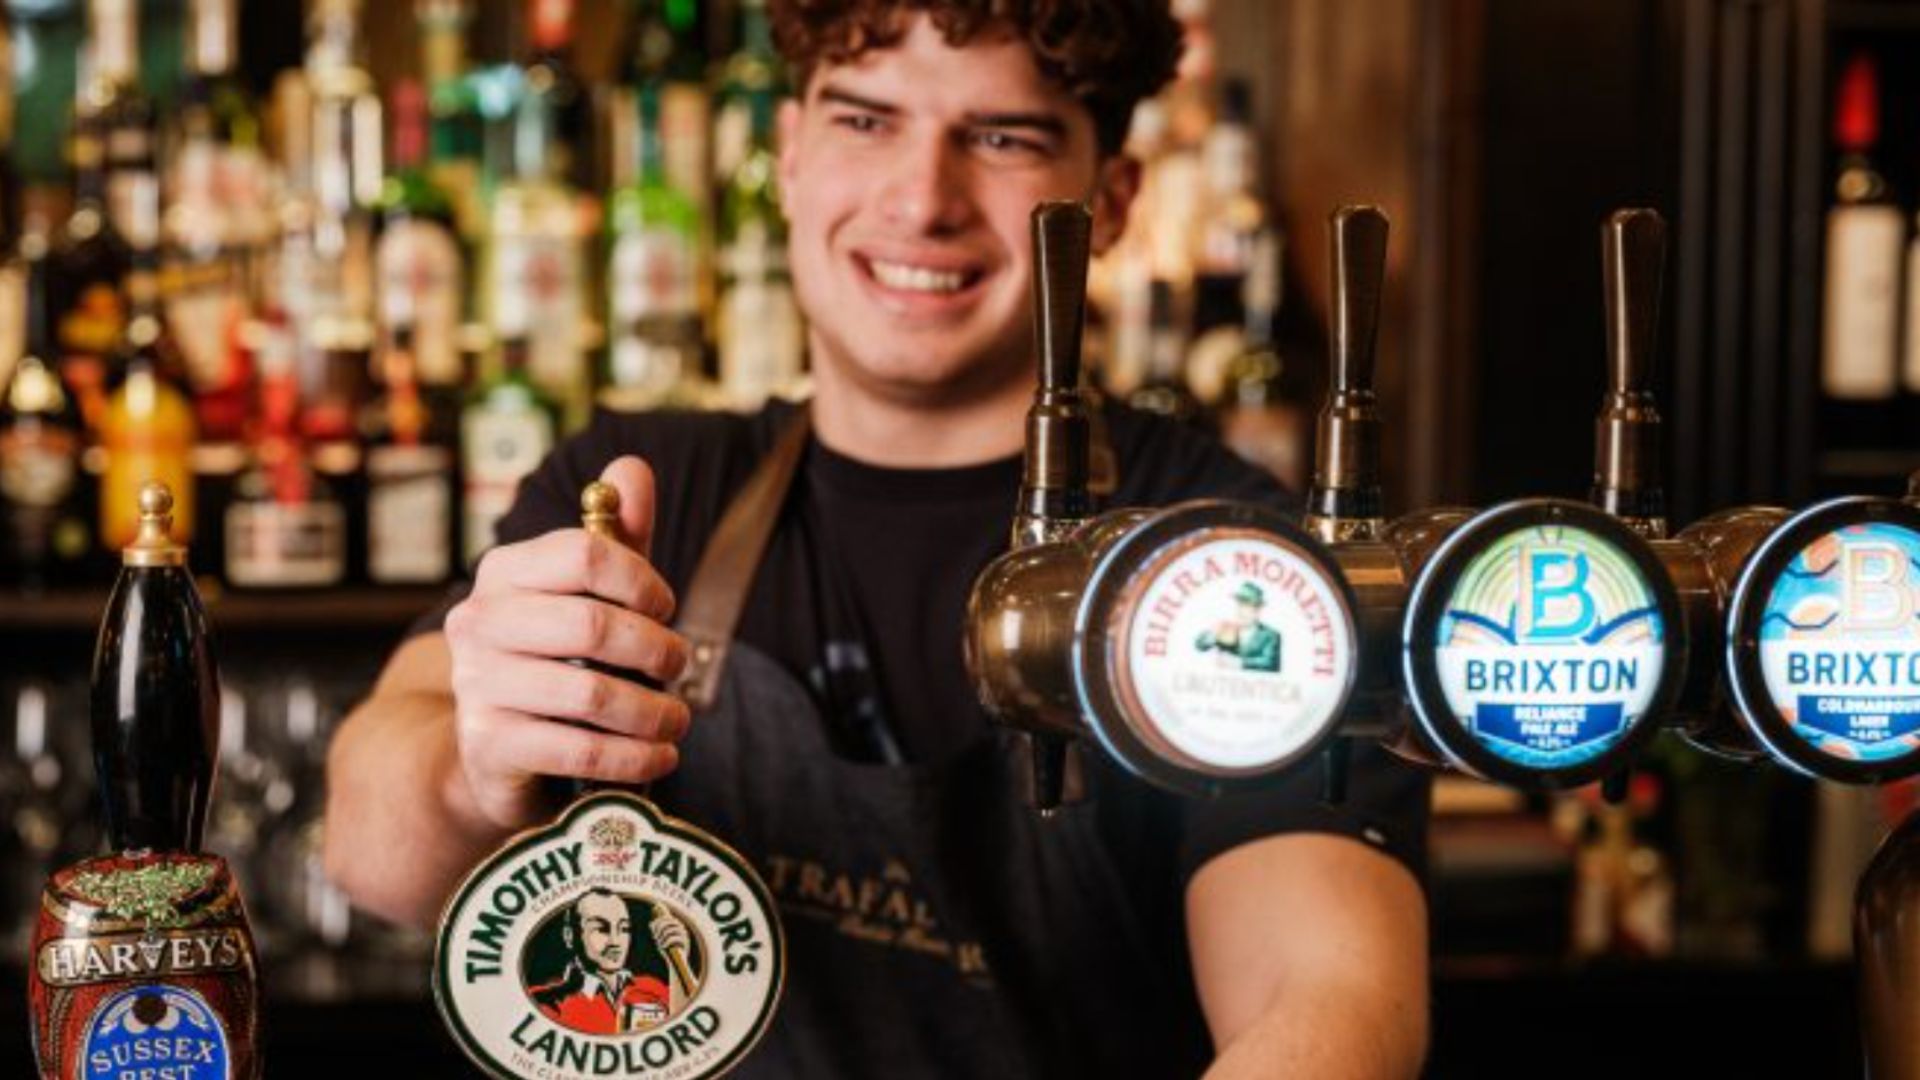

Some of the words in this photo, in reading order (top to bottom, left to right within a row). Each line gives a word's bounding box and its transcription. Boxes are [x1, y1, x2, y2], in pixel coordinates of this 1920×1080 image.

[1144, 554, 1226, 658] BIRRA
[1232, 551, 1335, 677] MORETTI
[1465, 658, 1638, 693] BRIXTON
[1787, 652, 1920, 685] BRIXTO
[466, 842, 583, 983] TIMOTHY
[639, 840, 763, 976] TAYLOR'S
[49, 934, 239, 979] HARVEYS
[90, 1037, 217, 1074] SUSSEX
[510, 1005, 722, 1075] LANDLORD
